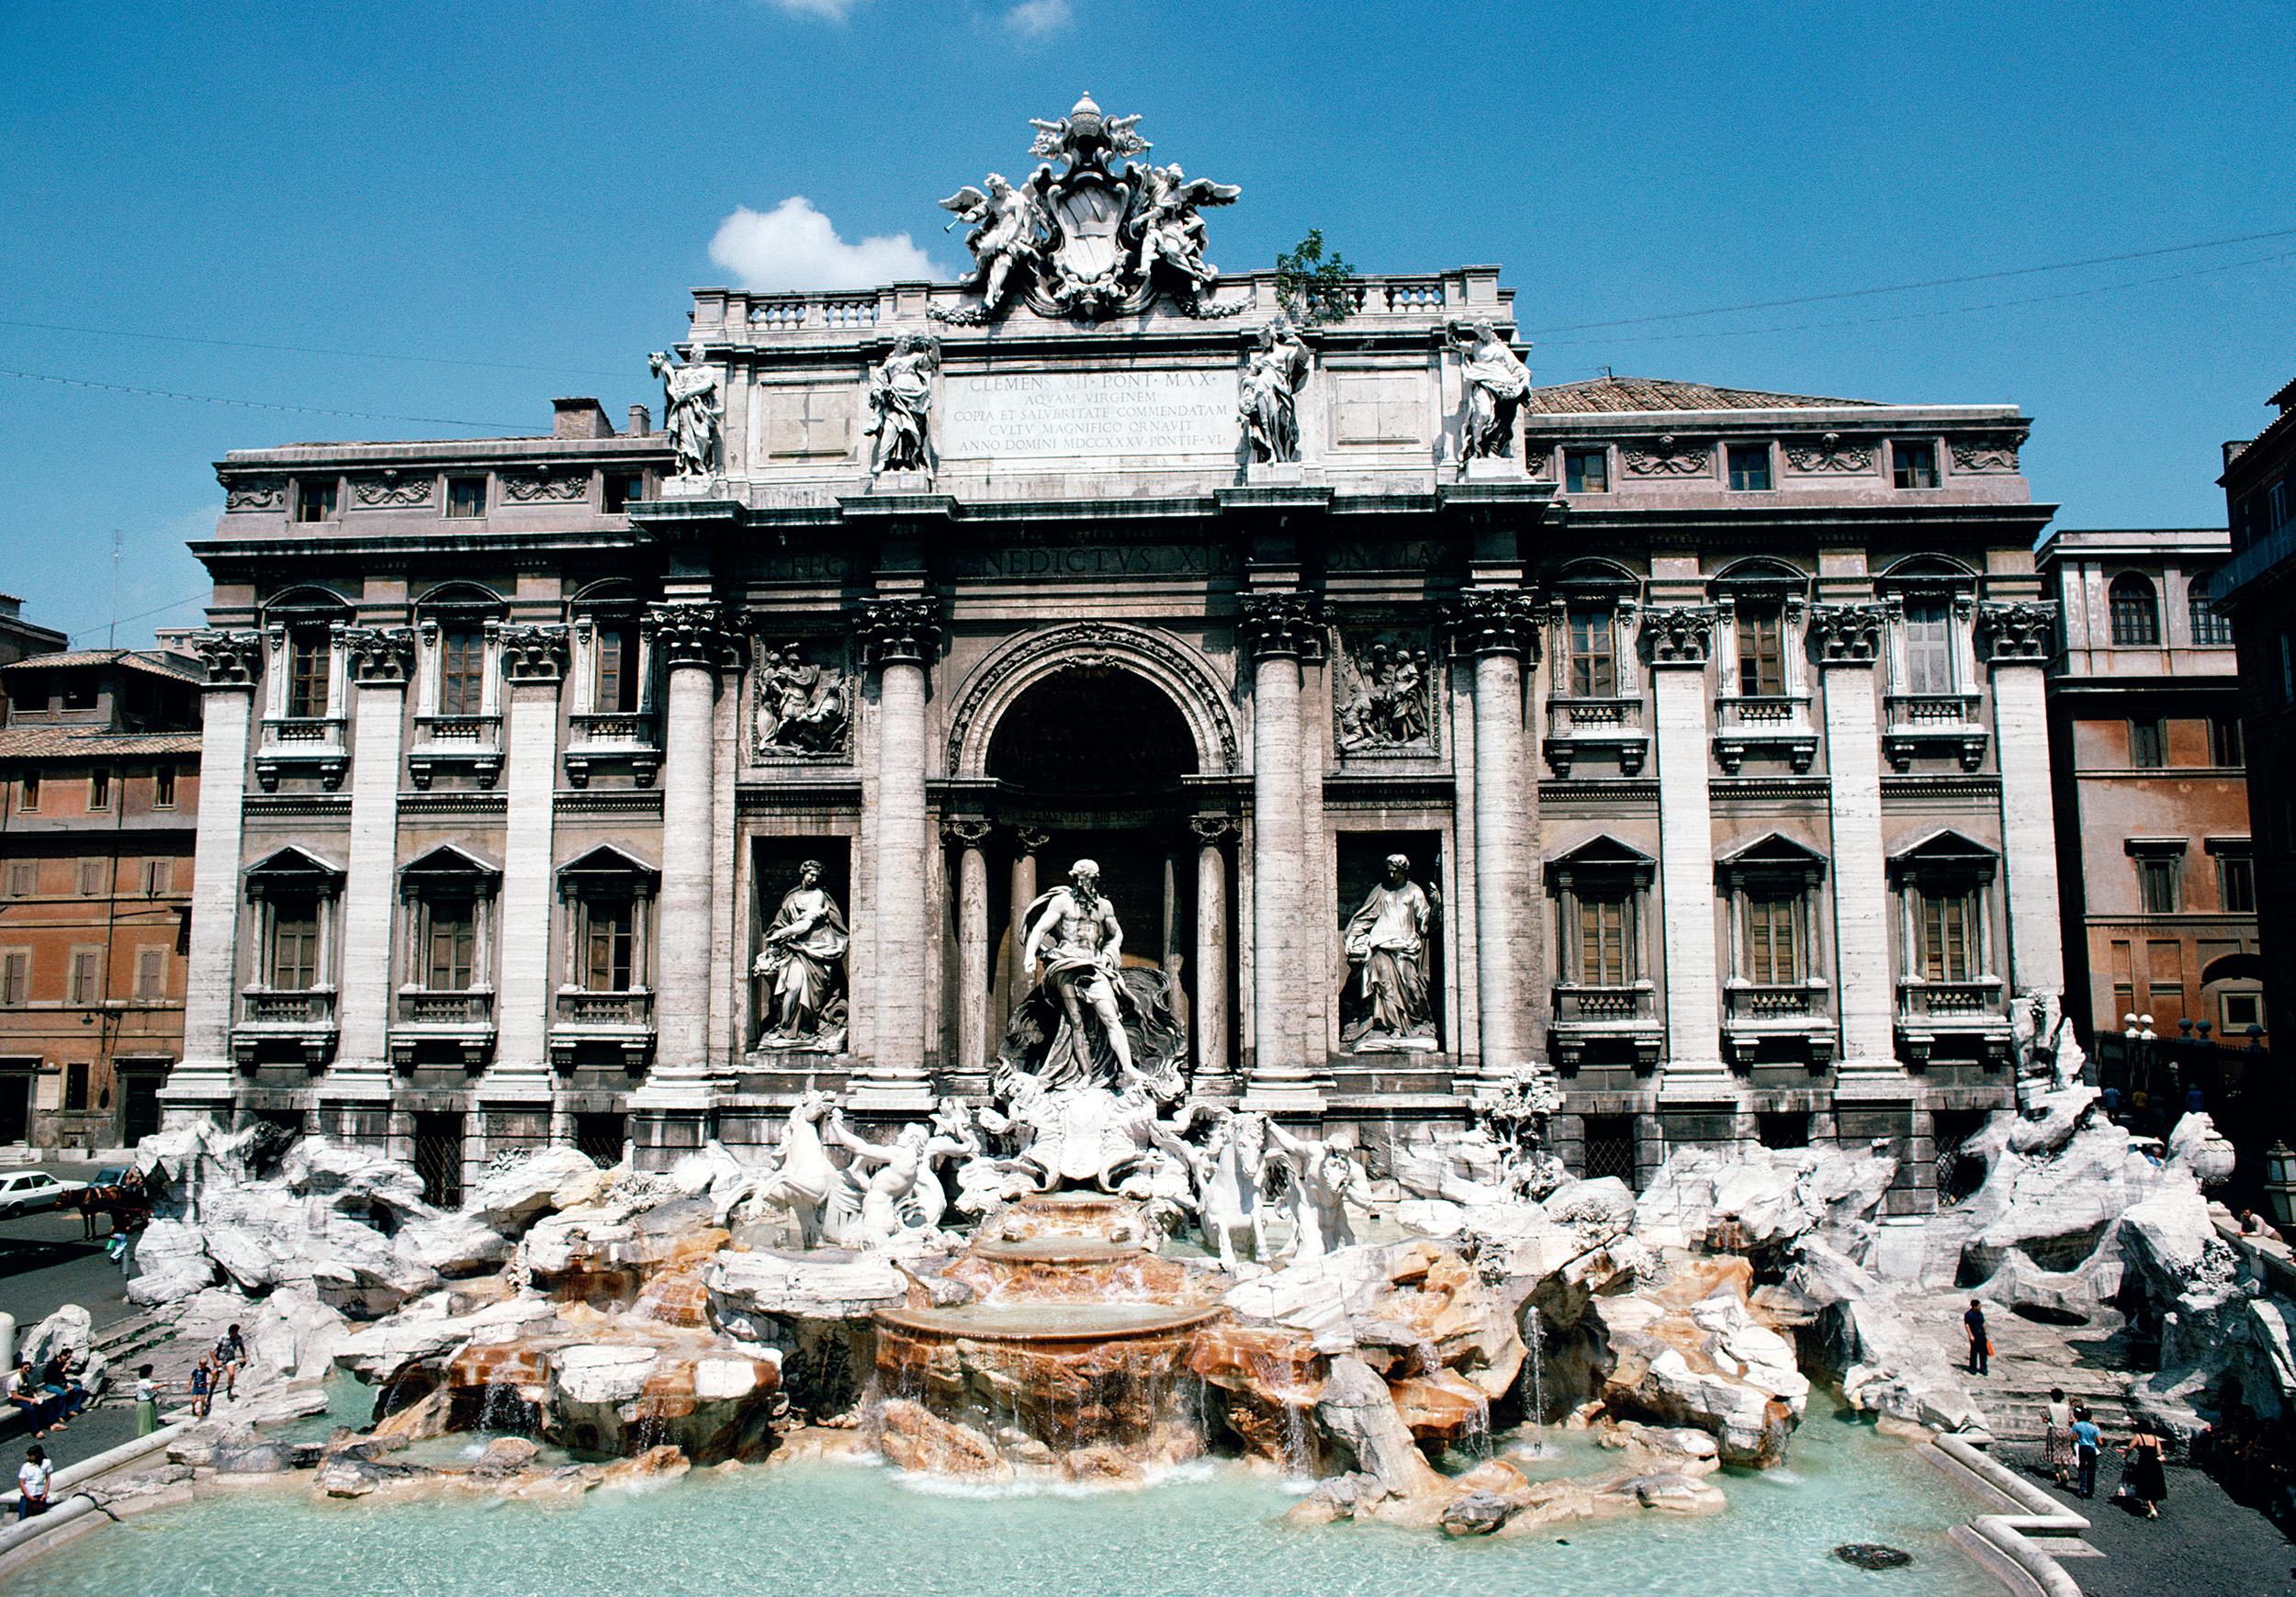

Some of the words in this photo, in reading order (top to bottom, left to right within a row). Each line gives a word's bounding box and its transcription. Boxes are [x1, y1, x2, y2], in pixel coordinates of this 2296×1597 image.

[970, 375, 1052, 392] CLEMENS
[1025, 392, 1075, 407] AQVAM
[1086, 390, 1156, 404] VIRGINEM
[953, 410, 994, 422] COPIA
[1000, 409, 1017, 421] ET
[1020, 406, 1109, 421] SALVBRITATE
[1116, 403, 1228, 418] COMMENDATAM
[988, 423, 1034, 436] CVLTV
[1042, 421, 1122, 435] MAGNIFICO
[1129, 419, 1193, 433] ORNAVIT
[959, 440, 1001, 452] ANNO
[1005, 437, 1057, 451] DOMINI
